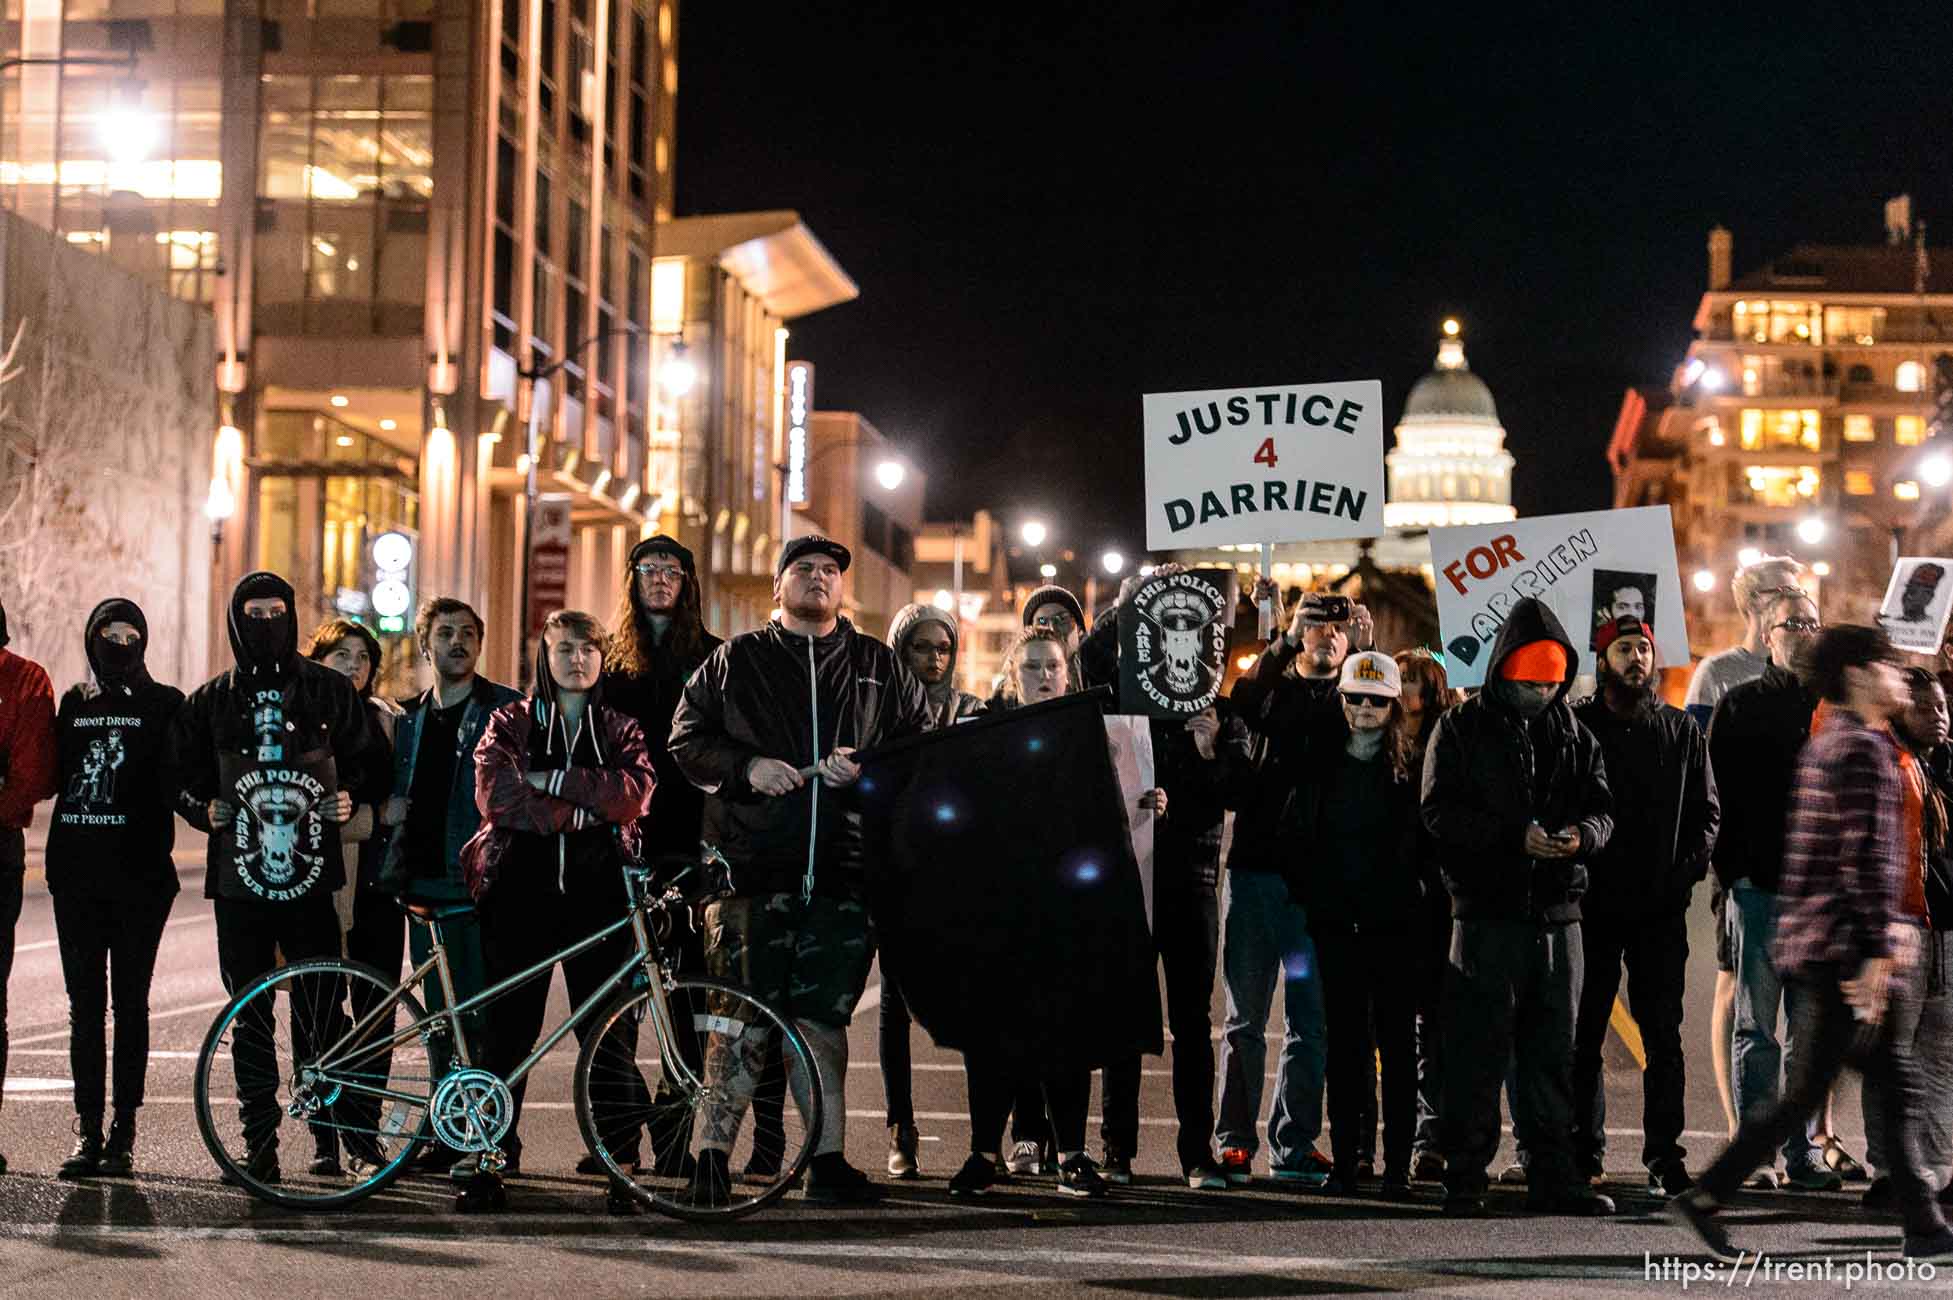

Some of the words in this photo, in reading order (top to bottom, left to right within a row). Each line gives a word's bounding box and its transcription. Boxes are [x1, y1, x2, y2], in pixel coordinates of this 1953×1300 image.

[1168, 393, 1363, 445] JUSTICE
[1254, 437, 1278, 468] 4
[1164, 480, 1367, 533] DARRIEN
[1443, 534, 1525, 596] FOR
[1134, 579, 1167, 607] THE
[1168, 574, 1226, 608] POLICE
[1447, 528, 1598, 666] DARRIEN
[1135, 622, 1151, 662] ARE
[1212, 623, 1225, 664] NOT
[1136, 669, 1169, 709] YOUR
[73, 716, 105, 727] SHOOT
[106, 716, 141, 728] DRUGS
[235, 771, 264, 795] THE
[266, 769, 325, 797] POLICE
[61, 813, 79, 824] NOT
[81, 814, 126, 825] PEOPLE
[235, 808, 249, 849] ARE
[309, 810, 322, 850] NOT
[233, 855, 265, 898] YOUR
[268, 856, 324, 901] FRIENDS
